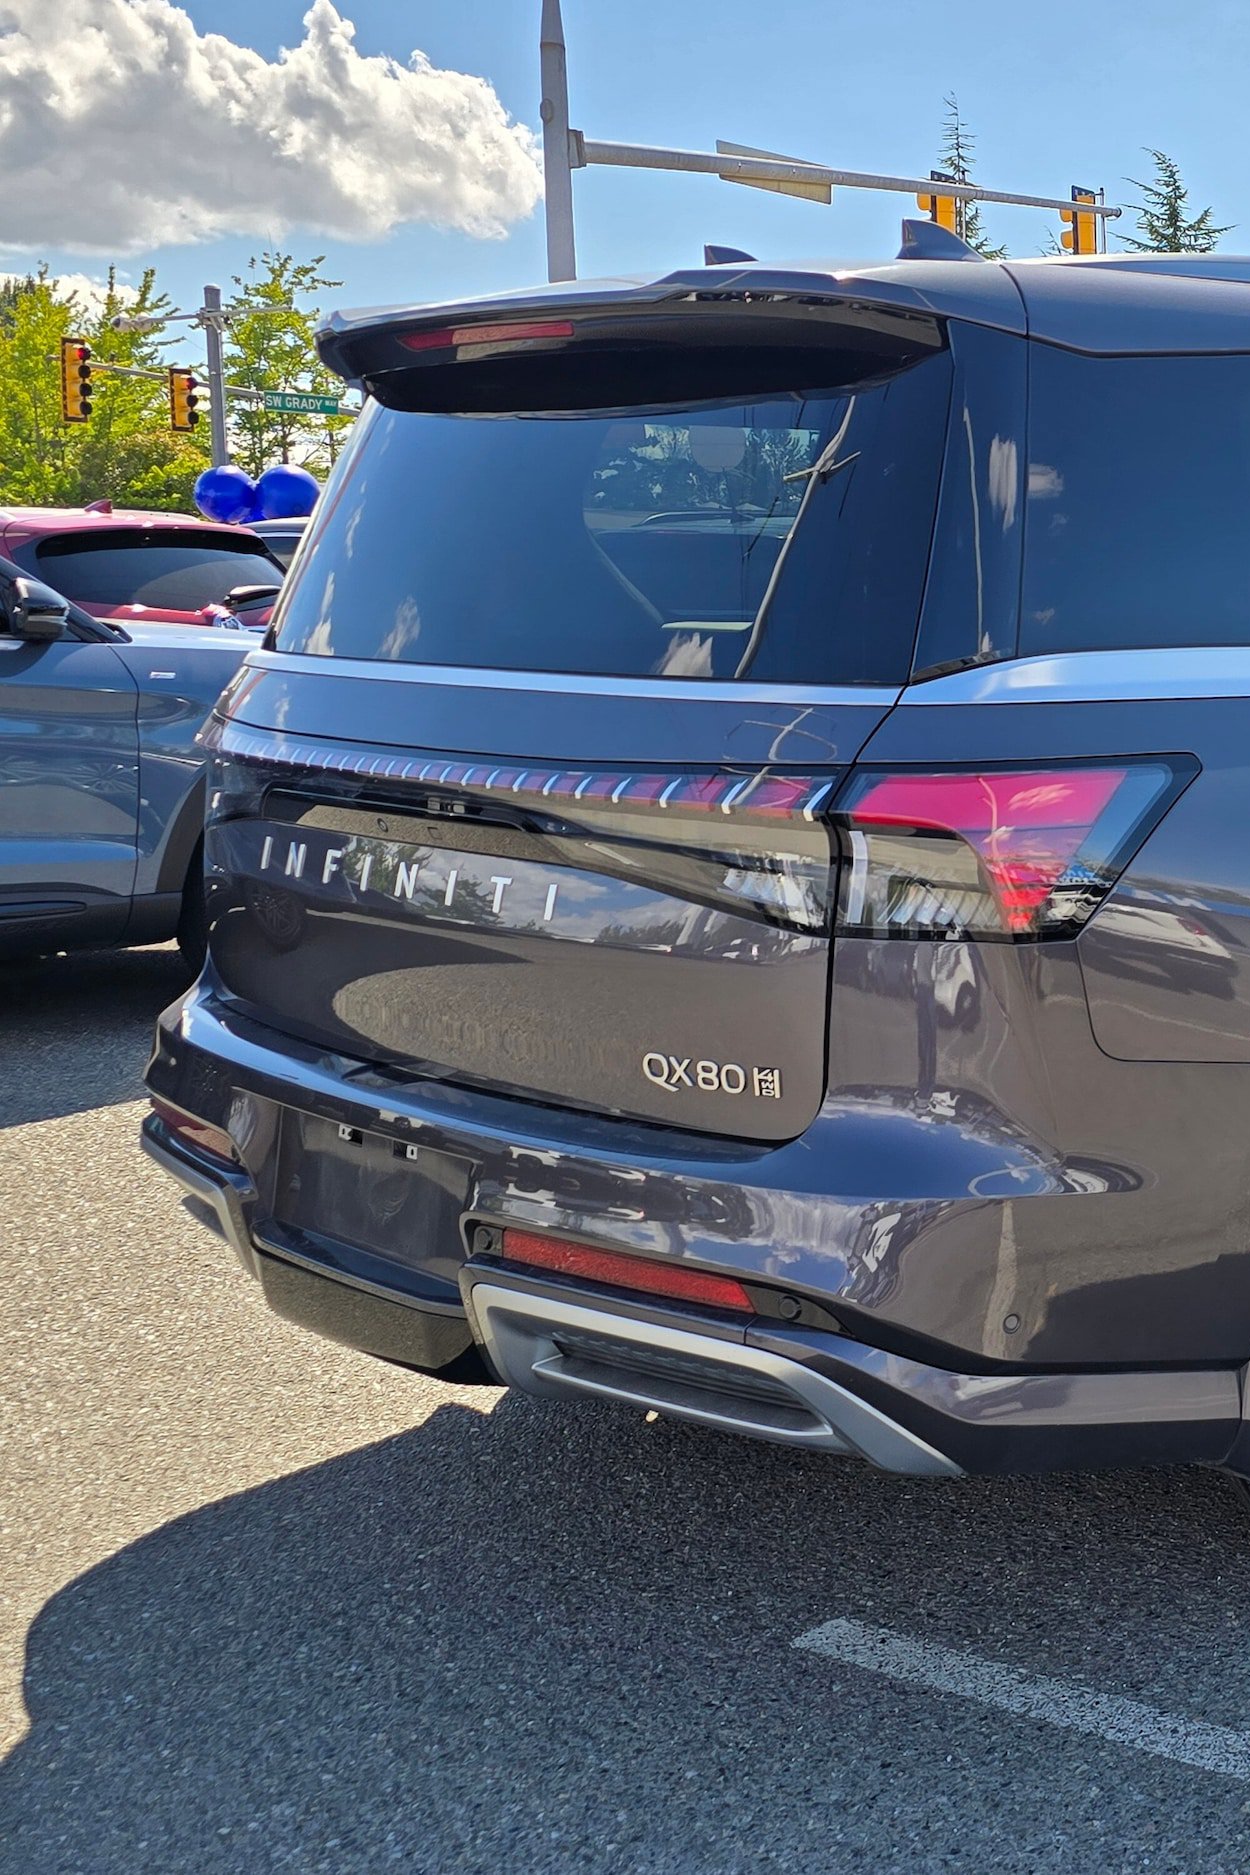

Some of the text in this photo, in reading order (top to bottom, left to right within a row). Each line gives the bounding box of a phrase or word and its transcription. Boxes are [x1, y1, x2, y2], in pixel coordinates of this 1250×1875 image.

[265, 395, 282, 407] SW
[285, 396, 323, 410] GRADY
[260, 836, 558, 921] INFINITI
[642, 1052, 746, 1093] QX80
